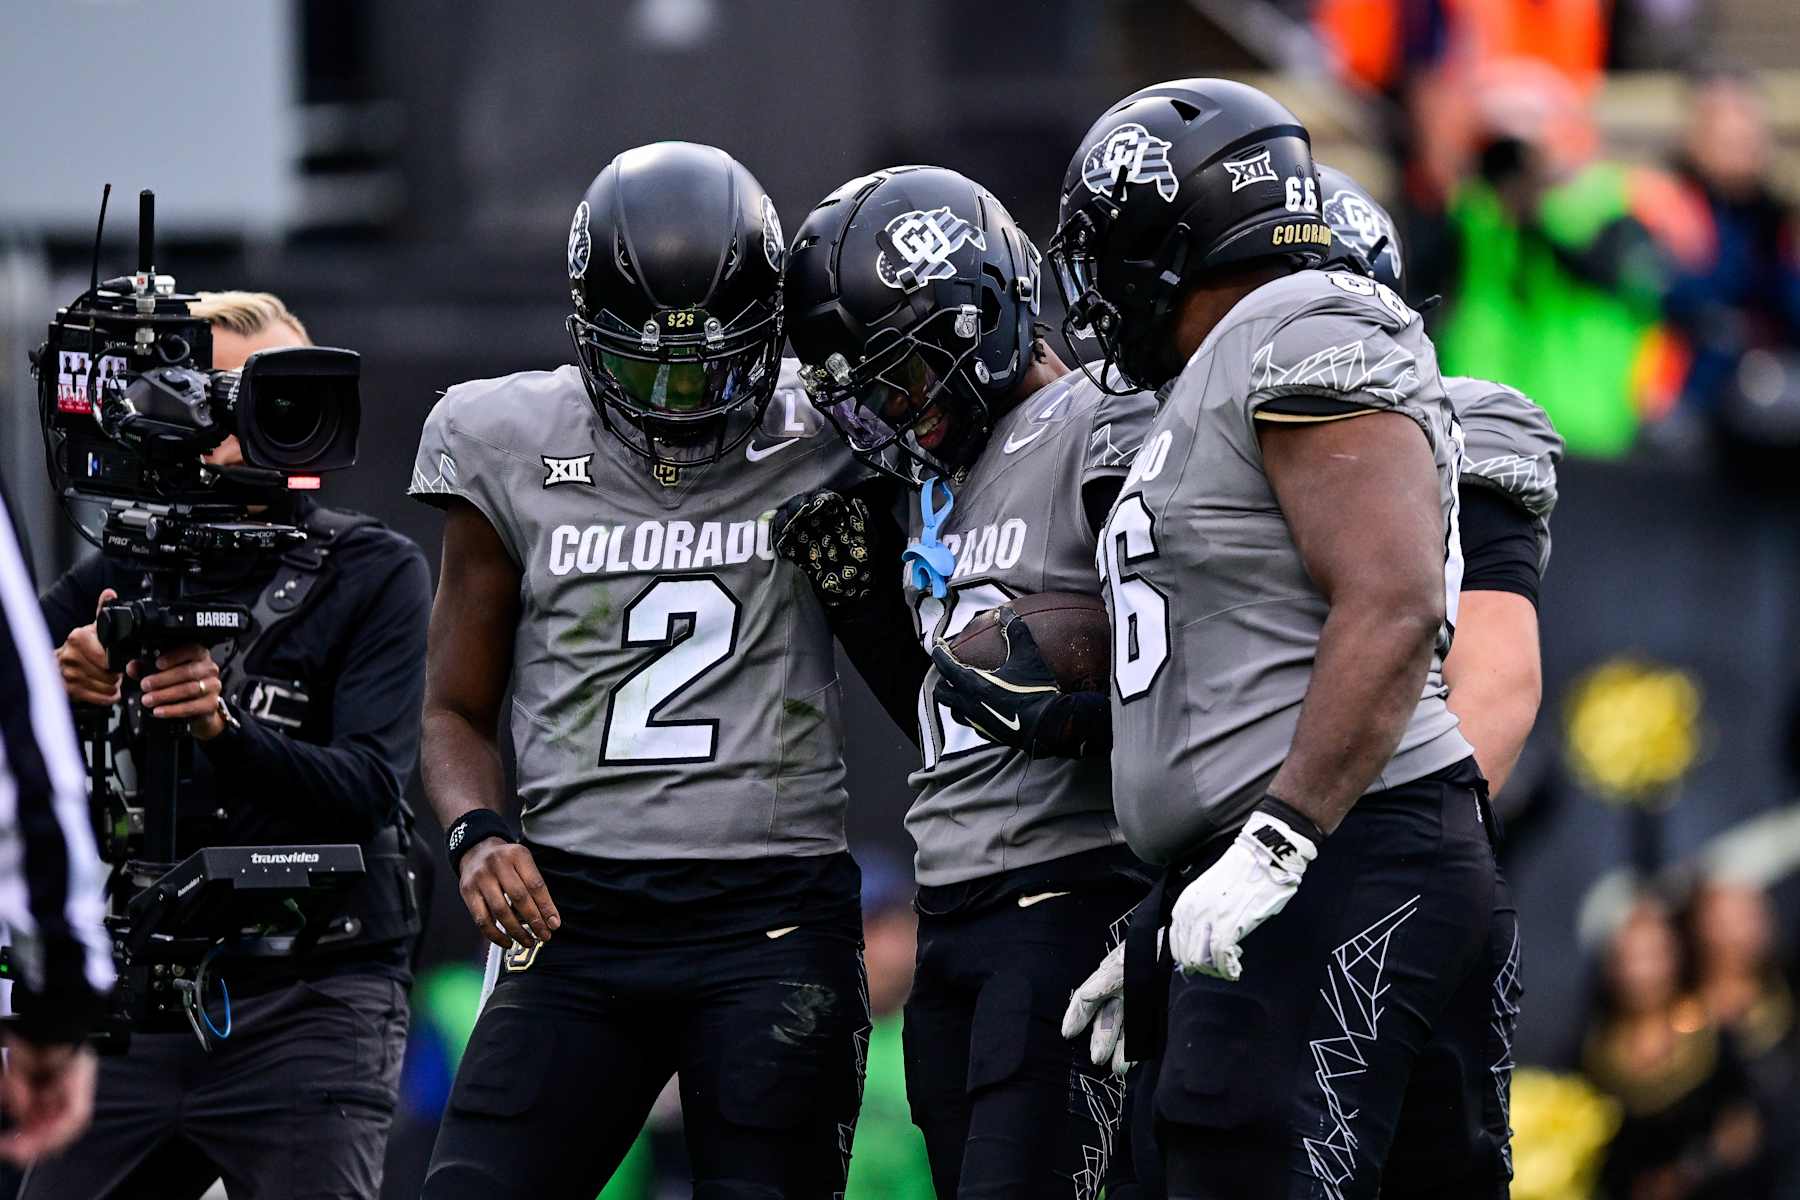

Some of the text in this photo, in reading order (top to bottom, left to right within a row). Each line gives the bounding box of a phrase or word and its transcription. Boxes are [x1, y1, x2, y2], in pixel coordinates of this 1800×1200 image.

[1285, 176, 1317, 212] 66
[784, 393, 805, 432] L
[541, 453, 595, 490] XII
[1094, 490, 1172, 707] 6
[196, 611, 239, 628] BARBER
[597, 572, 744, 768] 2
[250, 851, 320, 865] transvideo
